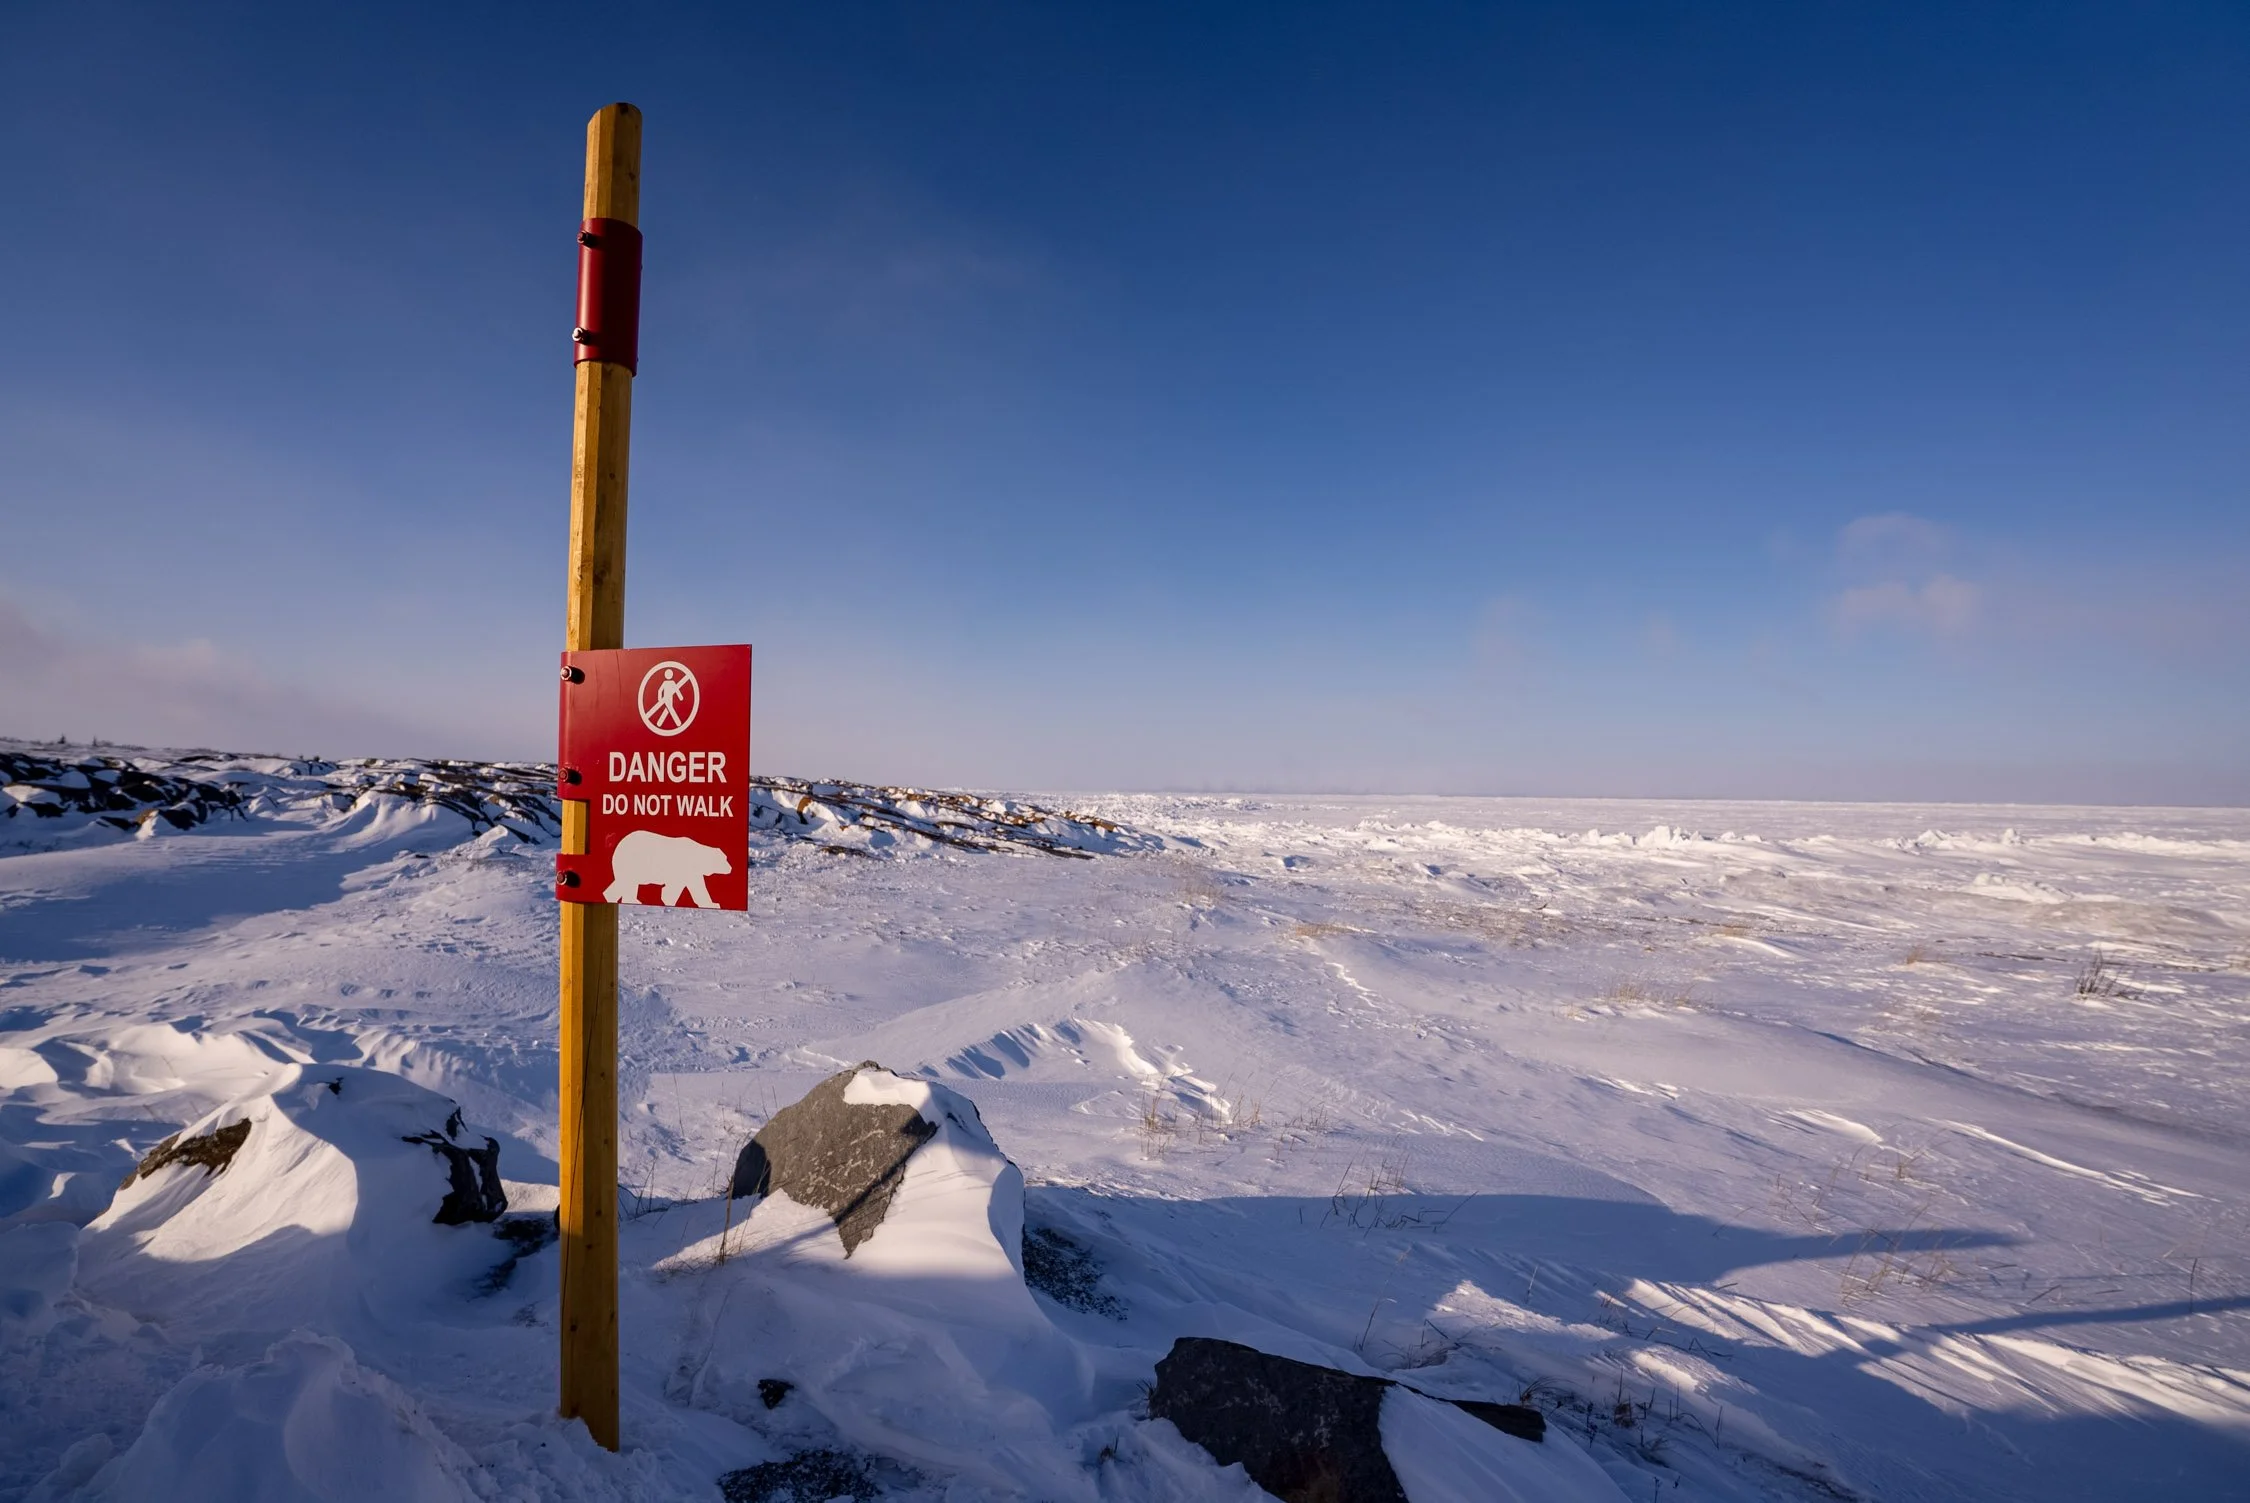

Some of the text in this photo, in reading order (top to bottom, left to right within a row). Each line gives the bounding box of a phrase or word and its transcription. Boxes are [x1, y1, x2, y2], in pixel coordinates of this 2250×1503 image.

[608, 751, 727, 783] DANGER
[602, 794, 734, 817] DO NOT WALK
